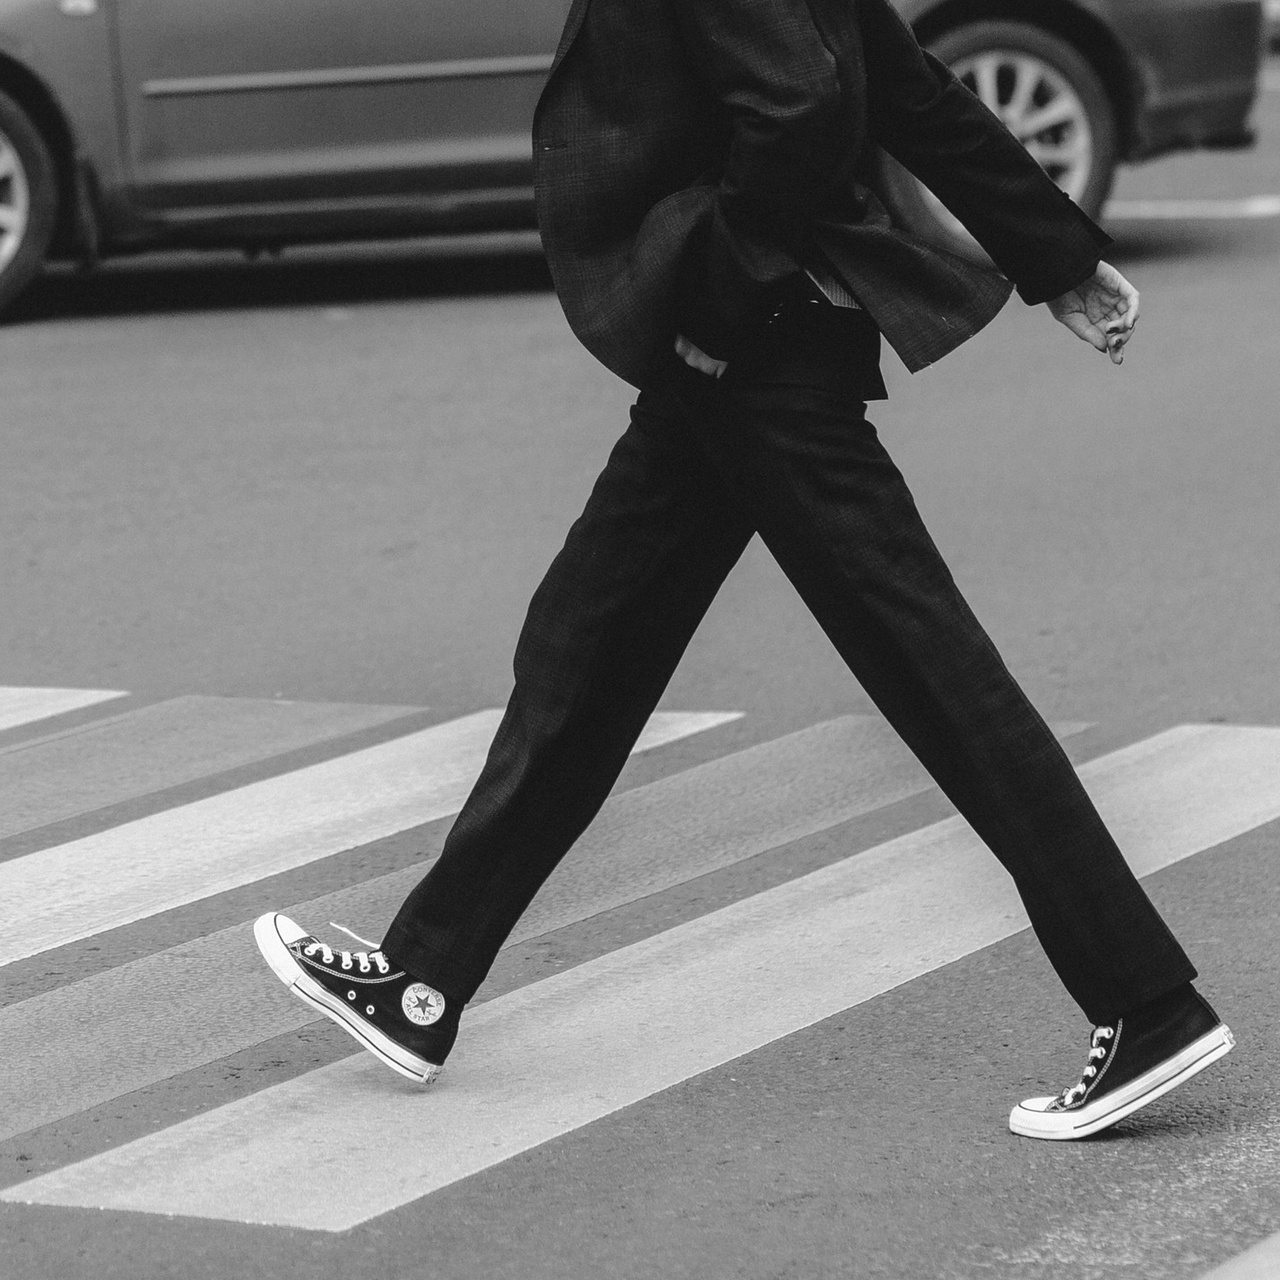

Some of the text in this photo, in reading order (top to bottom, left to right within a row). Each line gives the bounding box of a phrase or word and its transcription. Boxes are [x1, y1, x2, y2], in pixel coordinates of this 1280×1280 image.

[412, 985, 441, 1007] CONVERSE
[406, 1003, 430, 1022] ALL STAR
